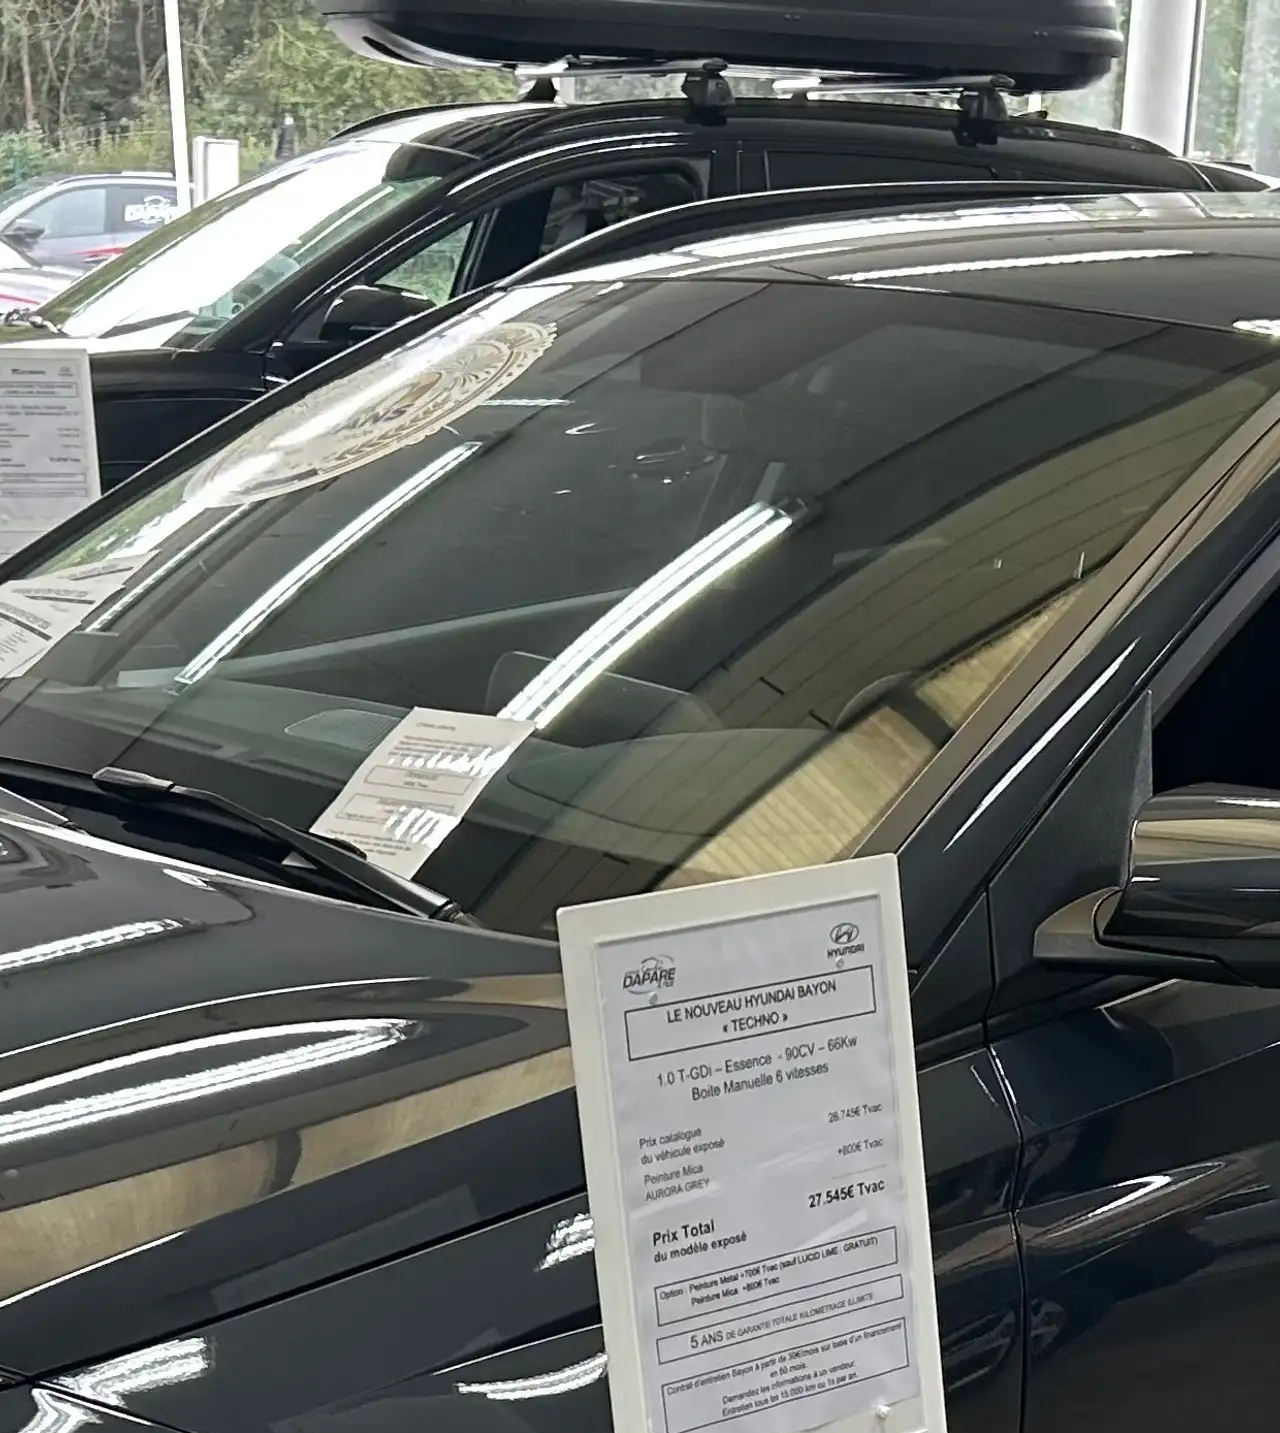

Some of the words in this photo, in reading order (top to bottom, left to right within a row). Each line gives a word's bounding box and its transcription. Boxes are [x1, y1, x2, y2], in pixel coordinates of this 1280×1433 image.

[666, 1008, 682, 1024] LE
[684, 996, 742, 1021] NOUVEAU
[743, 986, 795, 1009] HYUNDAI
[796, 979, 837, 999] BAYON
[730, 1010, 780, 1032] TECHNO
[677, 1063, 713, 1084] T-GDi
[723, 1050, 772, 1074] Essence
[722, 1071, 773, 1095] Manuelle
[774, 1069, 783, 1084] 6
[784, 1060, 829, 1082] vitesses
[638, 1135, 658, 1150] Prix
[658, 1125, 702, 1149] catalogue
[640, 1152, 654, 1166] du
[654, 1143, 691, 1162] véhicule
[692, 1136, 725, 1156] exposé
[862, 1136, 884, 1151] Tvac
[681, 1161, 704, 1178] Mica
[643, 1183, 684, 1202] AURORA
[683, 1176, 710, 1193] GREY
[807, 1183, 855, 1209] 27.545€
[856, 1176, 885, 1197] Tvac
[651, 1226, 679, 1248] Prix
[680, 1217, 715, 1240] Total
[653, 1250, 668, 1264] du
[668, 1239, 709, 1260] modèle
[710, 1229, 748, 1253] exposé
[689, 1333, 699, 1350] 5
[699, 1329, 724, 1347] ANS
[725, 1329, 736, 1340] DE
